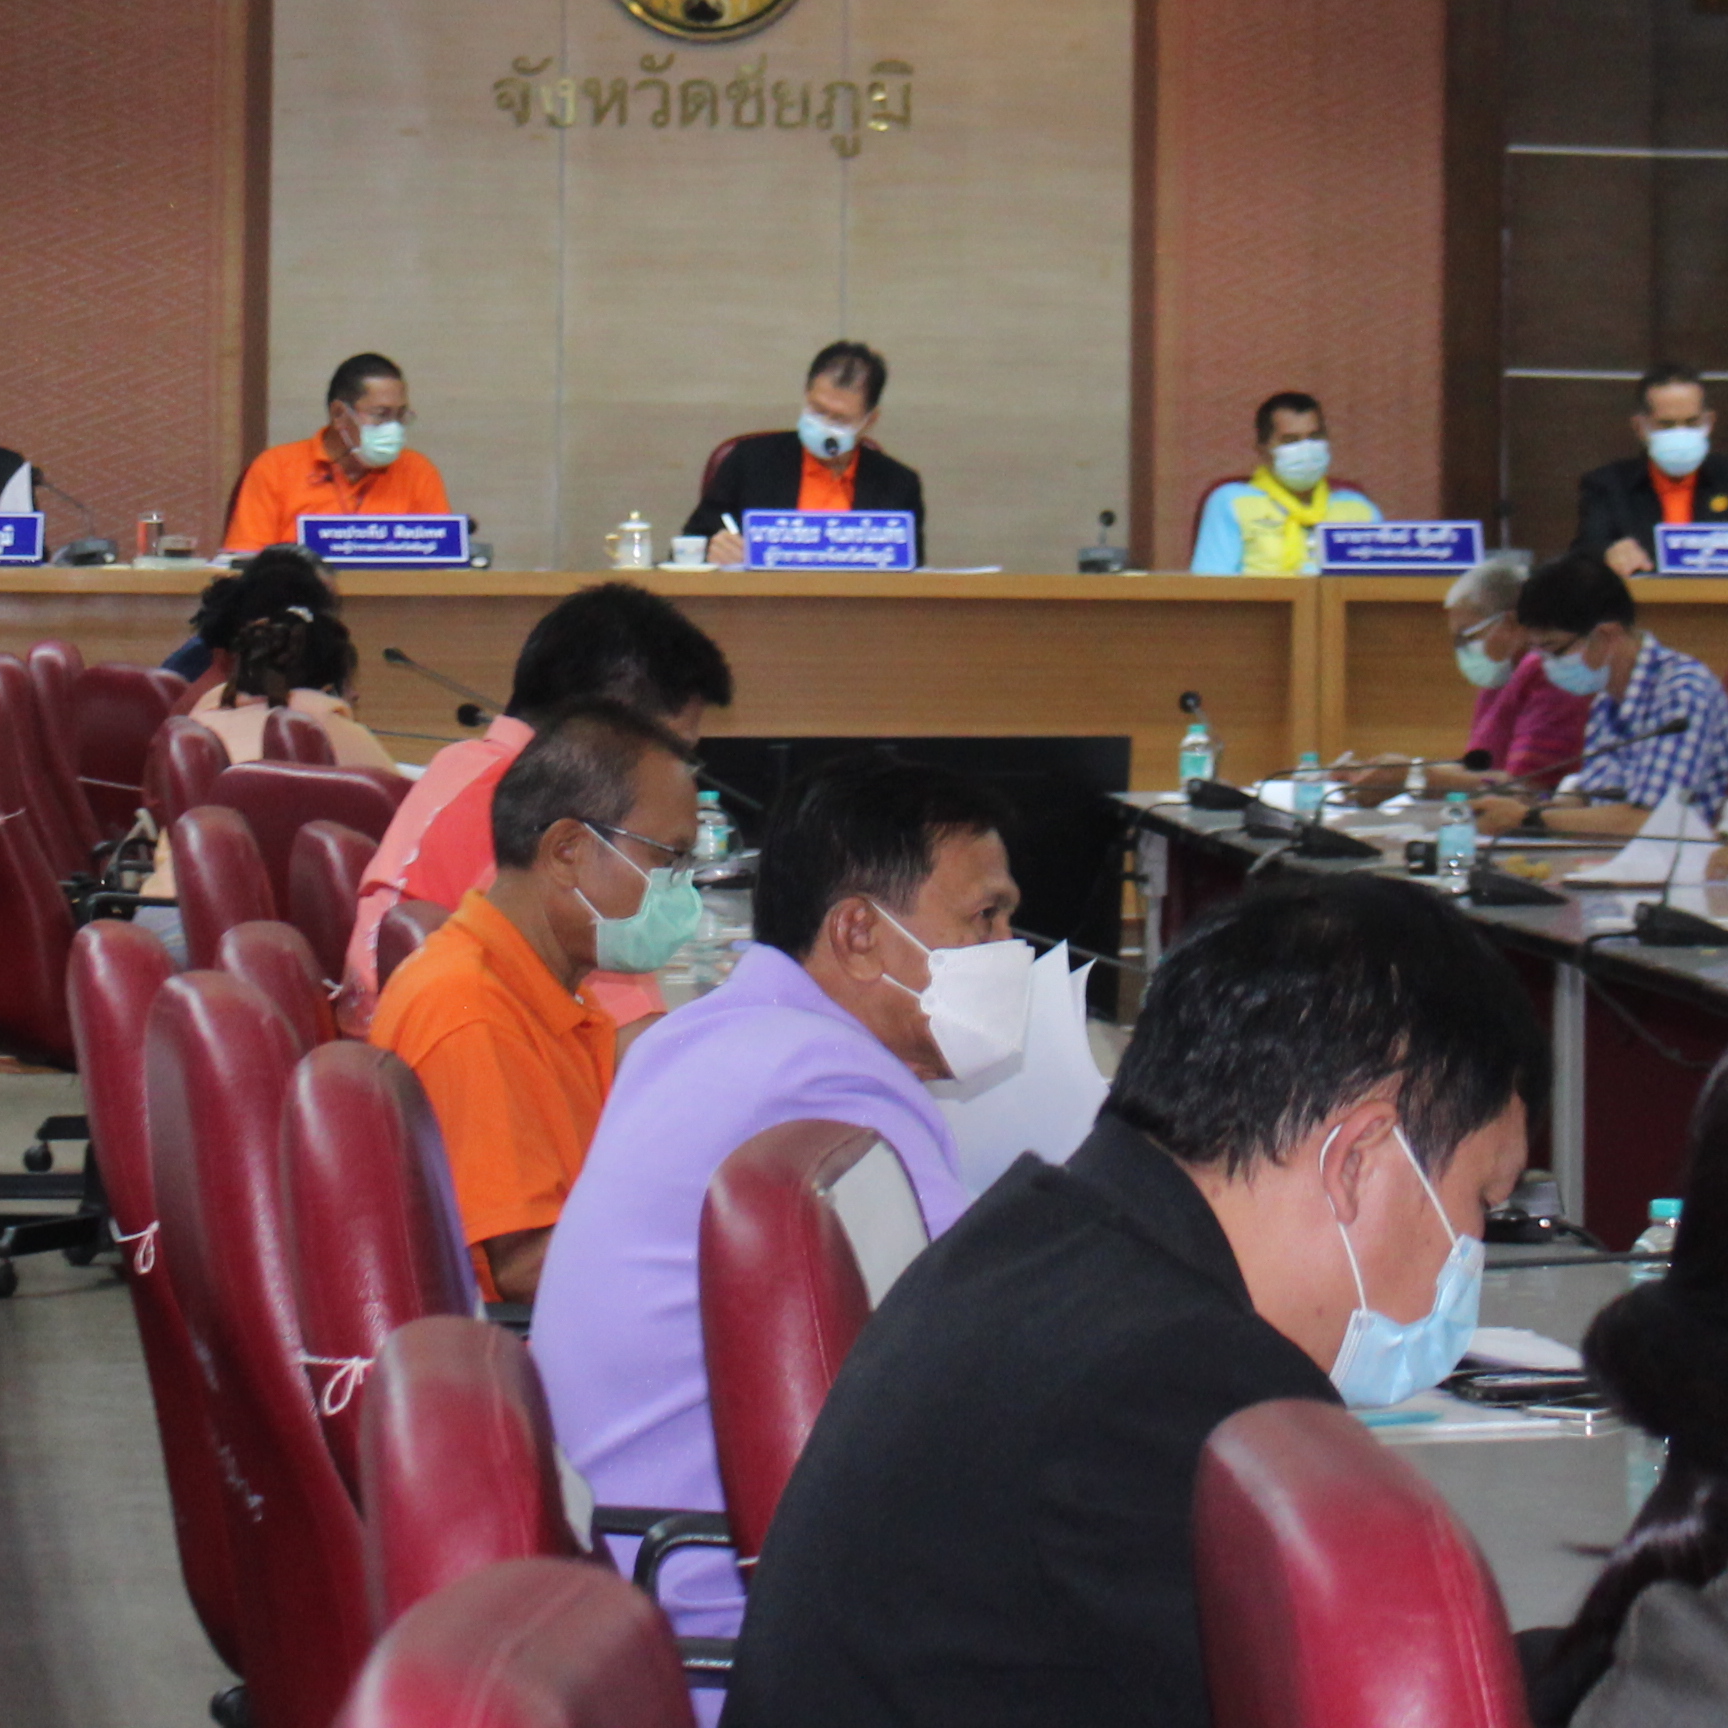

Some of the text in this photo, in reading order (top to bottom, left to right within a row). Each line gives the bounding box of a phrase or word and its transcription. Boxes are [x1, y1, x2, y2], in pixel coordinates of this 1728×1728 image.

[491, 52, 915, 159] จังหวัดชัยภูมิ
